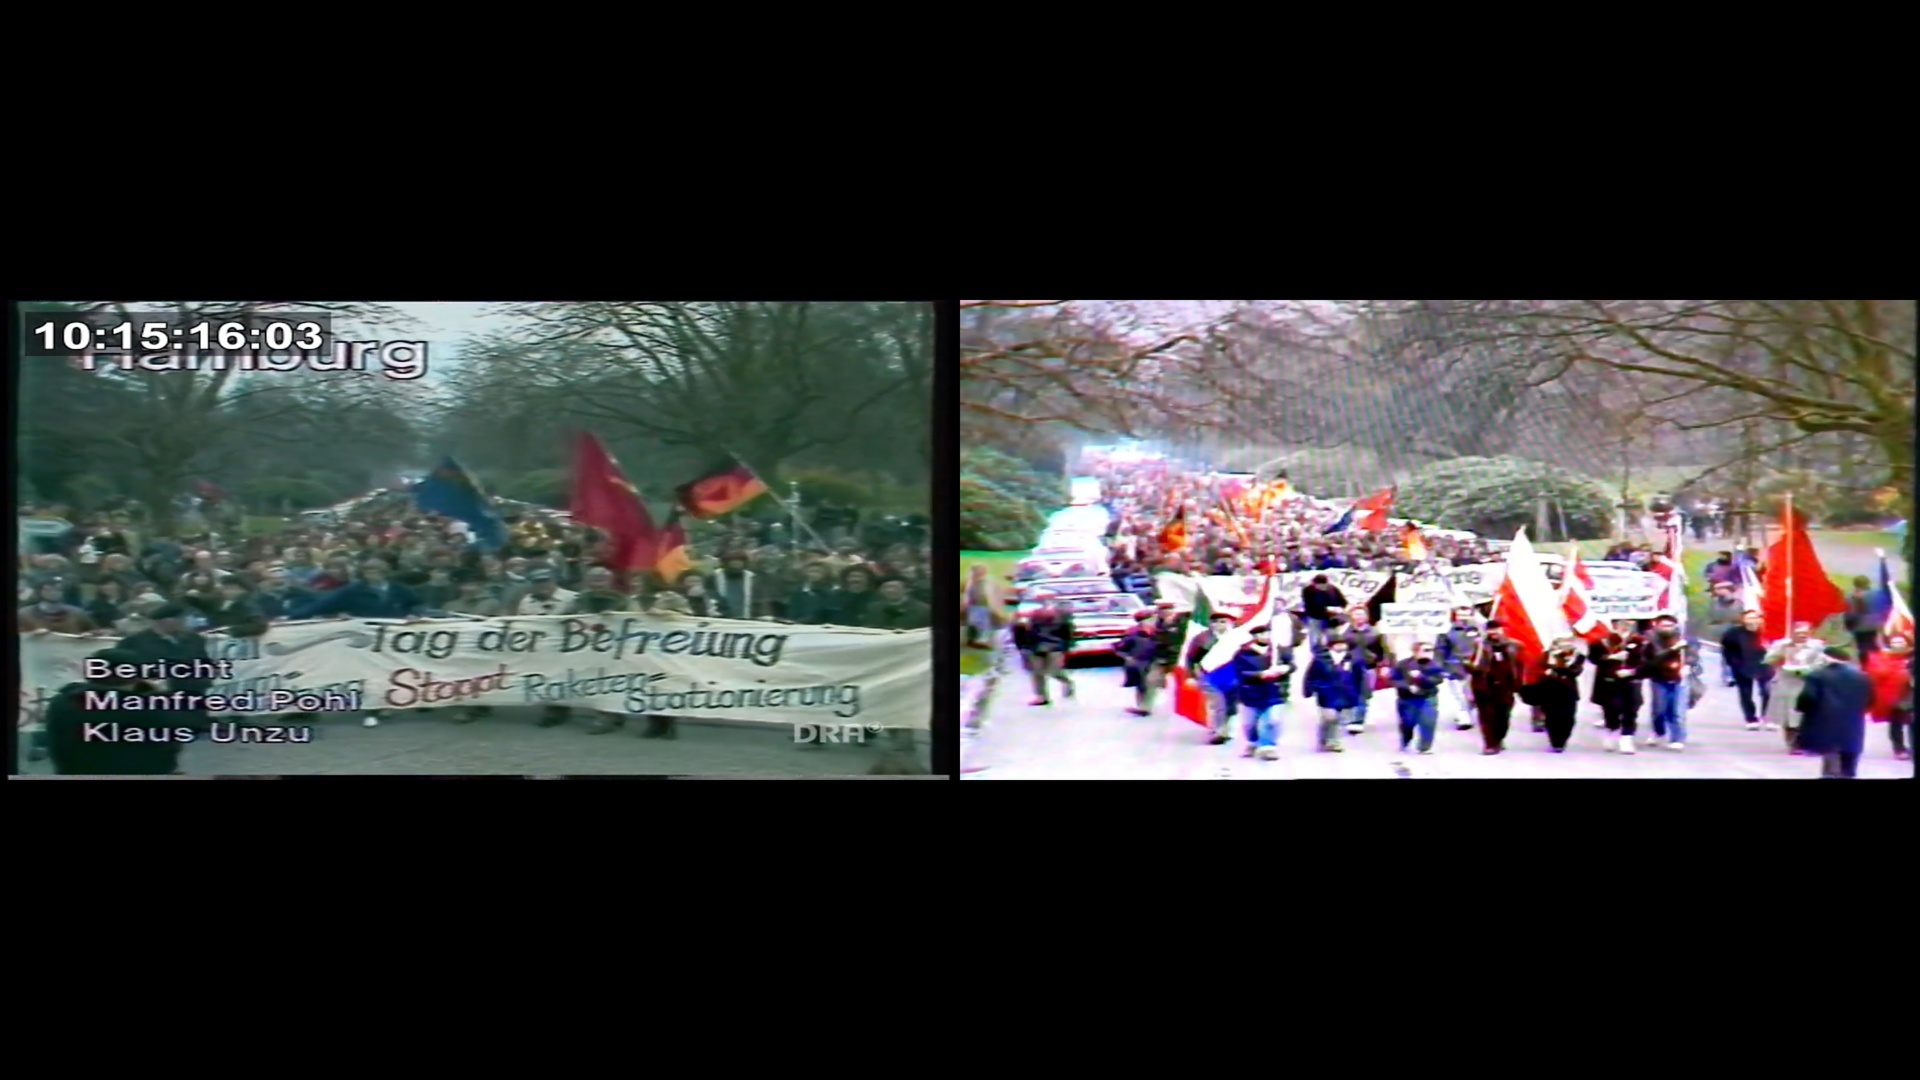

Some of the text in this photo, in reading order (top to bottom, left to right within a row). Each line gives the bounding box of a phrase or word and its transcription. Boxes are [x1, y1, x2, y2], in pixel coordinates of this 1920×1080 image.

[365, 618, 789, 667] Tag der Befreiung
[384, 664, 517, 707] Stoppt
[623, 679, 861, 718] Stationierung
